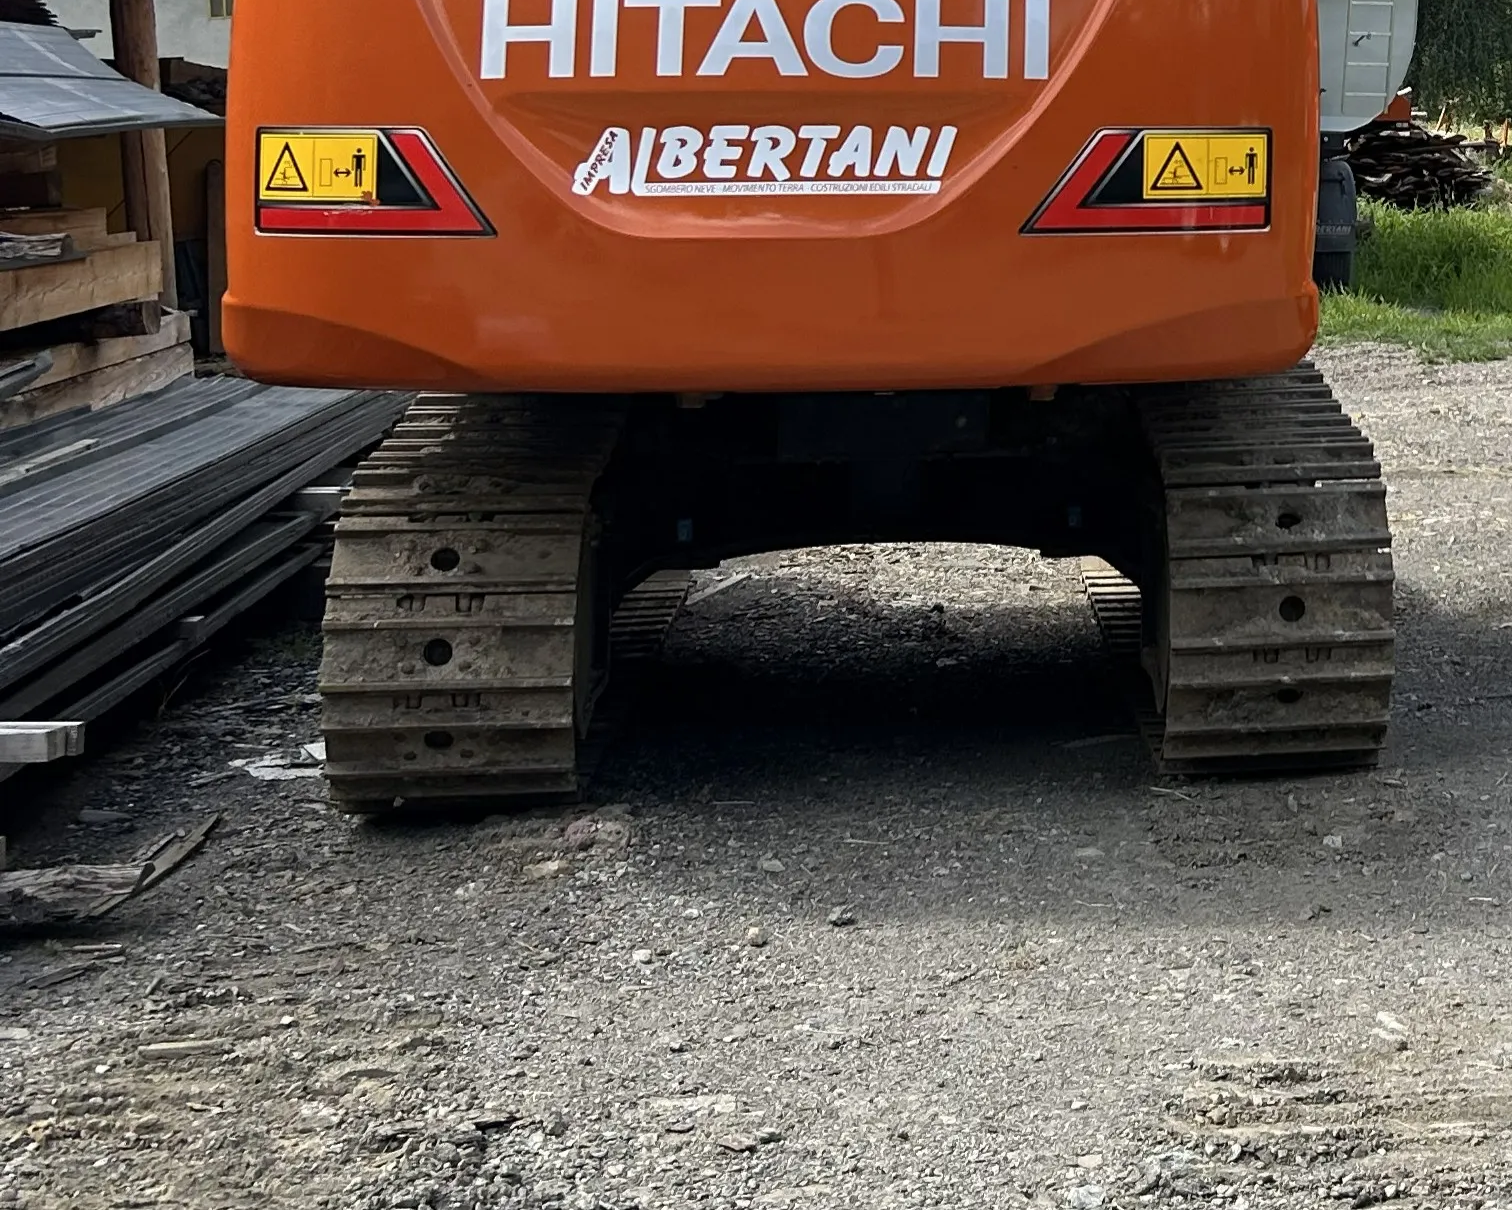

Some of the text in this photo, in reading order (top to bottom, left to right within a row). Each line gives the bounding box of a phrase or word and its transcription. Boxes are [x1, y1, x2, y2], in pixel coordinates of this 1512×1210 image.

[571, 125, 957, 197] ALBERTANI
[580, 130, 619, 191] IMPRESA
[645, 184, 693, 194] SGOMBERO
[695, 184, 716, 193] NEVE
[722, 184, 777, 193] MOVIMENTO
[778, 183, 804, 192] TERRA
[810, 183, 868, 192] COSTRUZIONI
